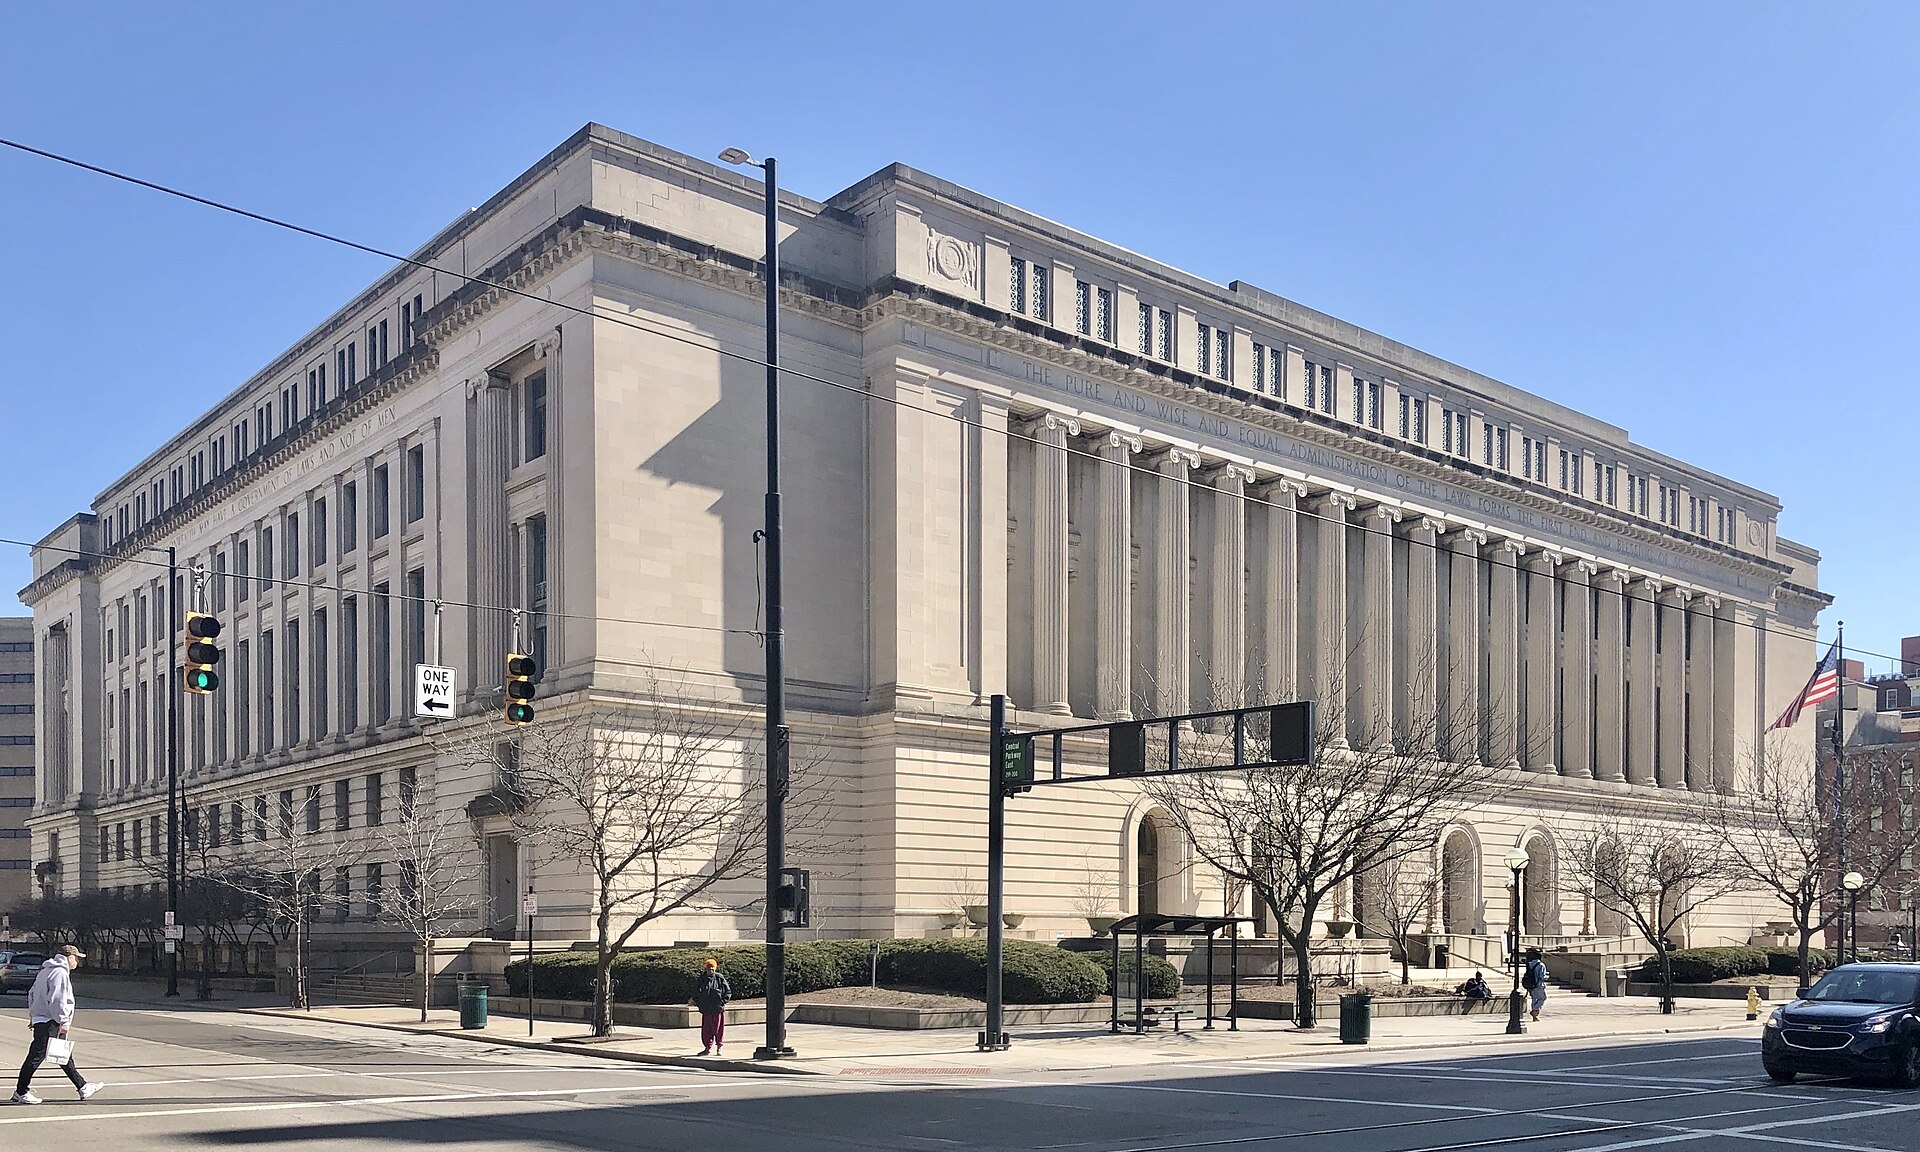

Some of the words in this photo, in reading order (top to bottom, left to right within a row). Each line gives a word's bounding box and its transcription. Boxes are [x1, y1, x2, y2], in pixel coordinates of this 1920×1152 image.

[297, 454, 315, 477] LAWS
[319, 443, 336, 463] AND
[339, 431, 358, 450] NOT
[361, 421, 372, 438] OF
[378, 405, 396, 427] MEN
[1022, 361, 1052, 386] THE
[1065, 374, 1103, 400] PURE
[1114, 390, 1147, 412] AND
[1156, 401, 1189, 426] WISE
[1199, 415, 1229, 437] AND
[1239, 427, 1279, 451] EQUAL
[1289, 442, 1388, 485] ADMINISTRATION
[1396, 473, 1410, 488] OF
[1418, 479, 1437, 497] THE
[1445, 488, 1471, 508] LAWS
[1479, 497, 1511, 519] FORMS
[1517, 509, 1533, 525] THE
[1541, 514, 1563, 534] FIRST
[1569, 525, 1588, 541] END
[423, 669, 449, 683] ONE
[423, 683, 449, 696] WAY
